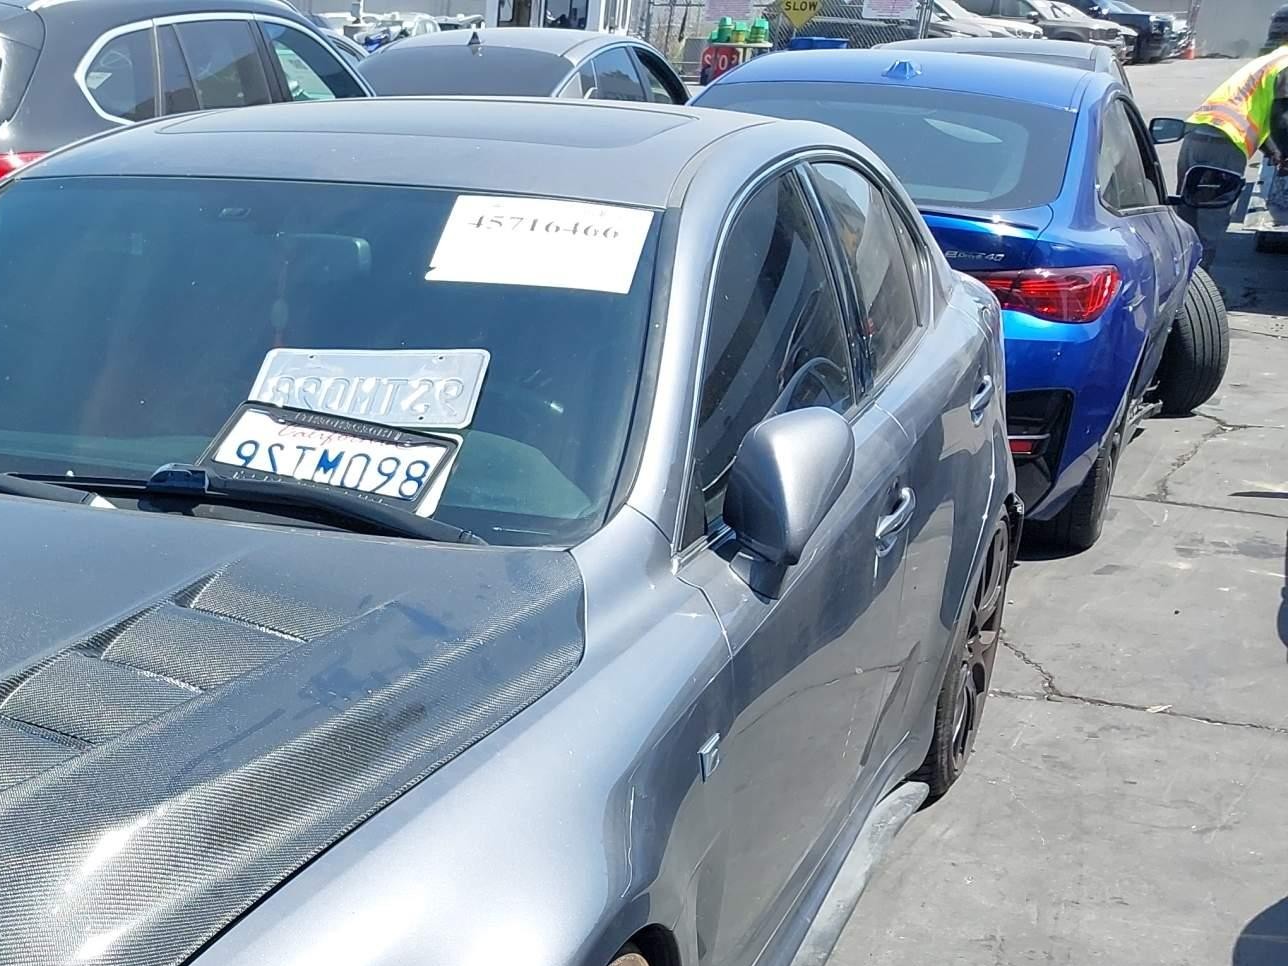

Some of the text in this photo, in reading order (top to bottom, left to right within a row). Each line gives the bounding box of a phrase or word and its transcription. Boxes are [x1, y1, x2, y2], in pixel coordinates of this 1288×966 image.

[784, 0, 818, 11] SLOW
[468, 213, 620, 240] 45716466
[235, 439, 431, 500] 9STM098
